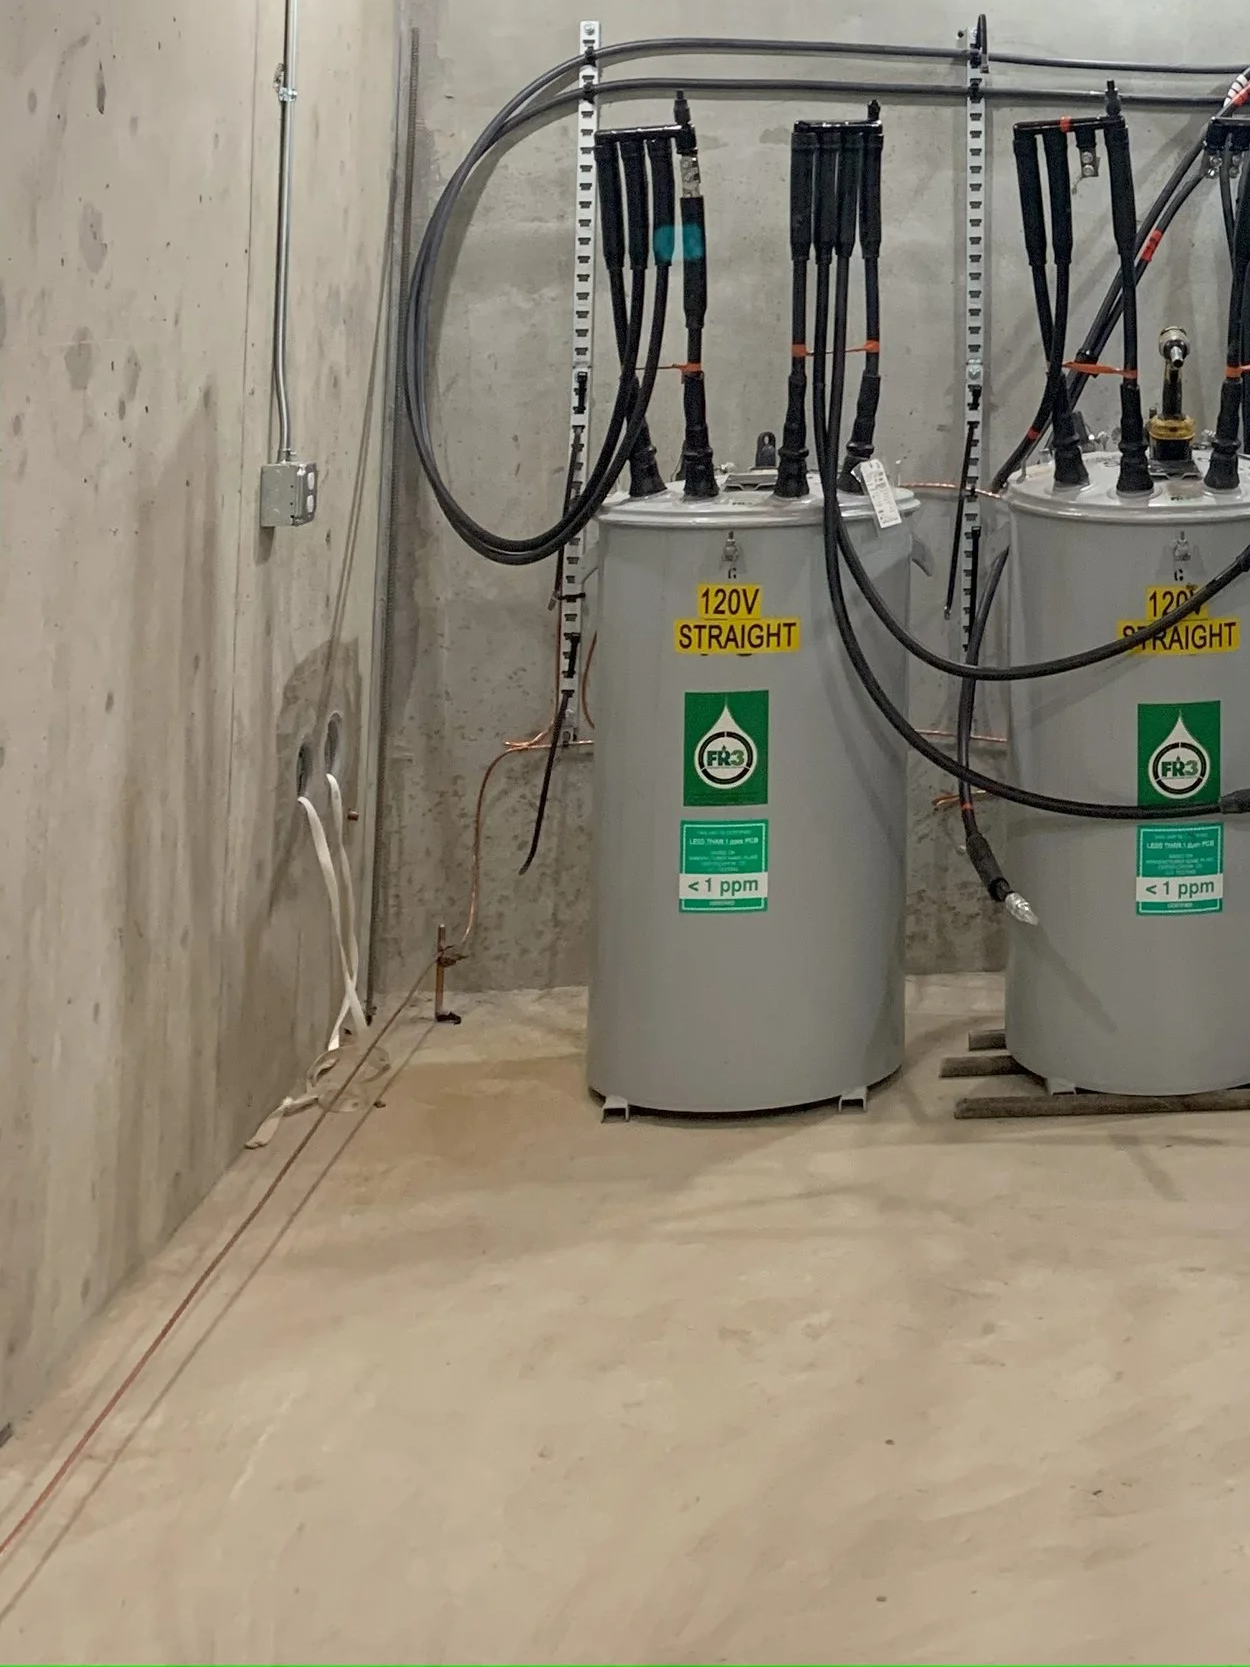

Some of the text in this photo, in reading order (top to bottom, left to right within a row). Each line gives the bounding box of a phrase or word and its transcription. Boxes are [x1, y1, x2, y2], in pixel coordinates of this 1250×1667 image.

[701, 588, 760, 615] 120V
[679, 622, 797, 649] STRAIGHT
[707, 749, 745, 766] FR3
[1161, 759, 1199, 777] FR3
[688, 877, 759, 897] < 1 ppm
[1145, 881, 1215, 899] < 1 ppm
